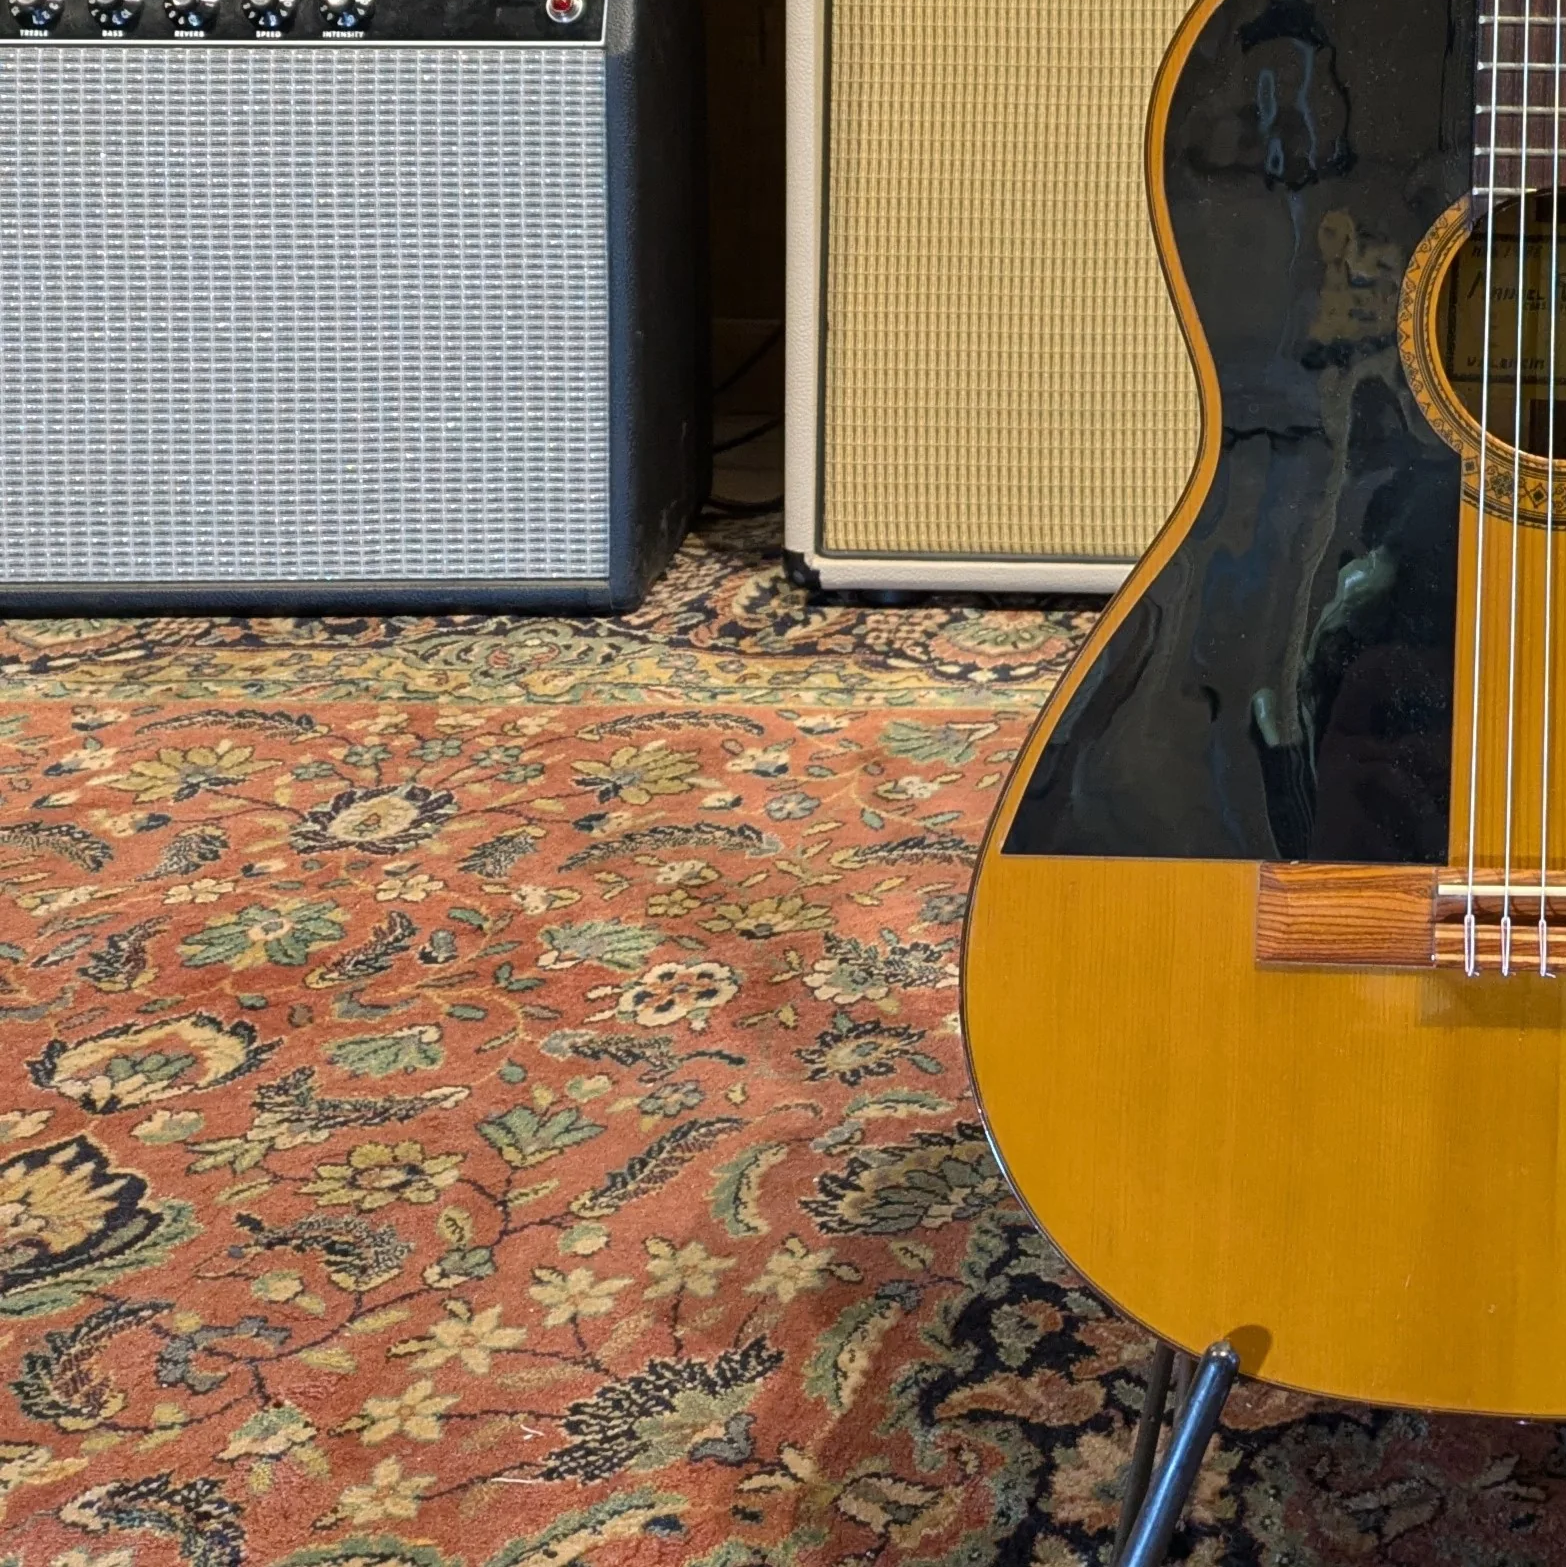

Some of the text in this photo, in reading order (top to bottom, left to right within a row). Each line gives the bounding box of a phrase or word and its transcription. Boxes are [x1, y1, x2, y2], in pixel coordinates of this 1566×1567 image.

[19, 29, 49, 38] TREBLE
[101, 29, 124, 38] BASS
[174, 30, 205, 38] REVERB
[255, 30, 282, 39] SPEED
[322, 30, 365, 39] INTENSITY
